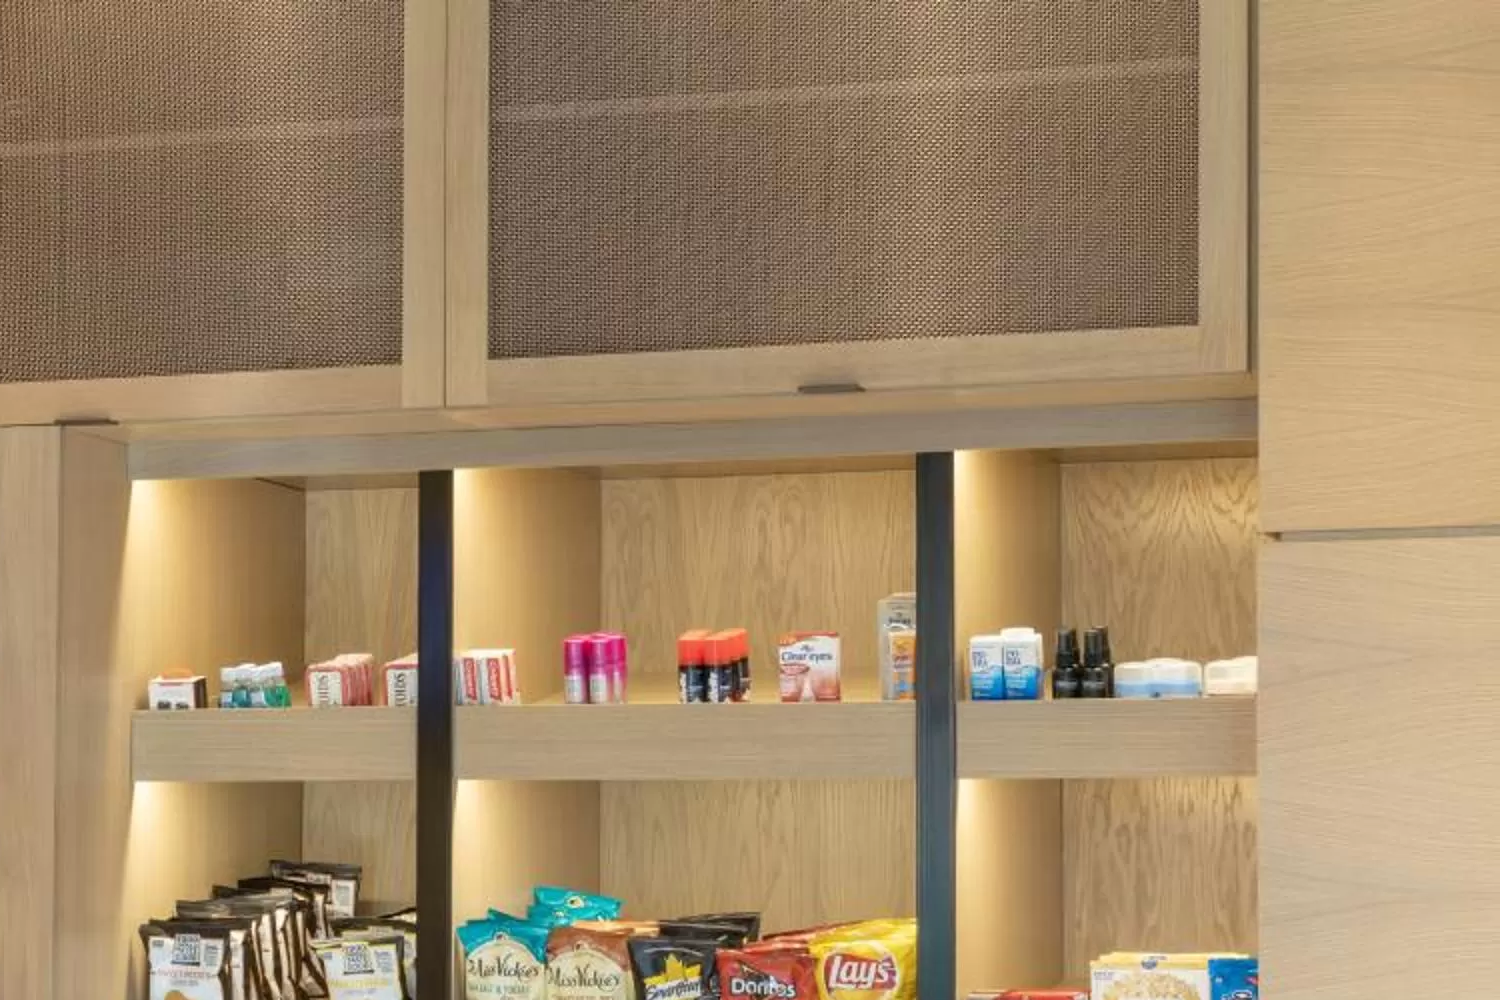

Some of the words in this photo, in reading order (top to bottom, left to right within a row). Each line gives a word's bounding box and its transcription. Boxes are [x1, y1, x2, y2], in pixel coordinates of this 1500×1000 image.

[808, 653, 833, 665] eyes
[829, 955, 893, 989] Lay's
[730, 976, 797, 999] Doritos
